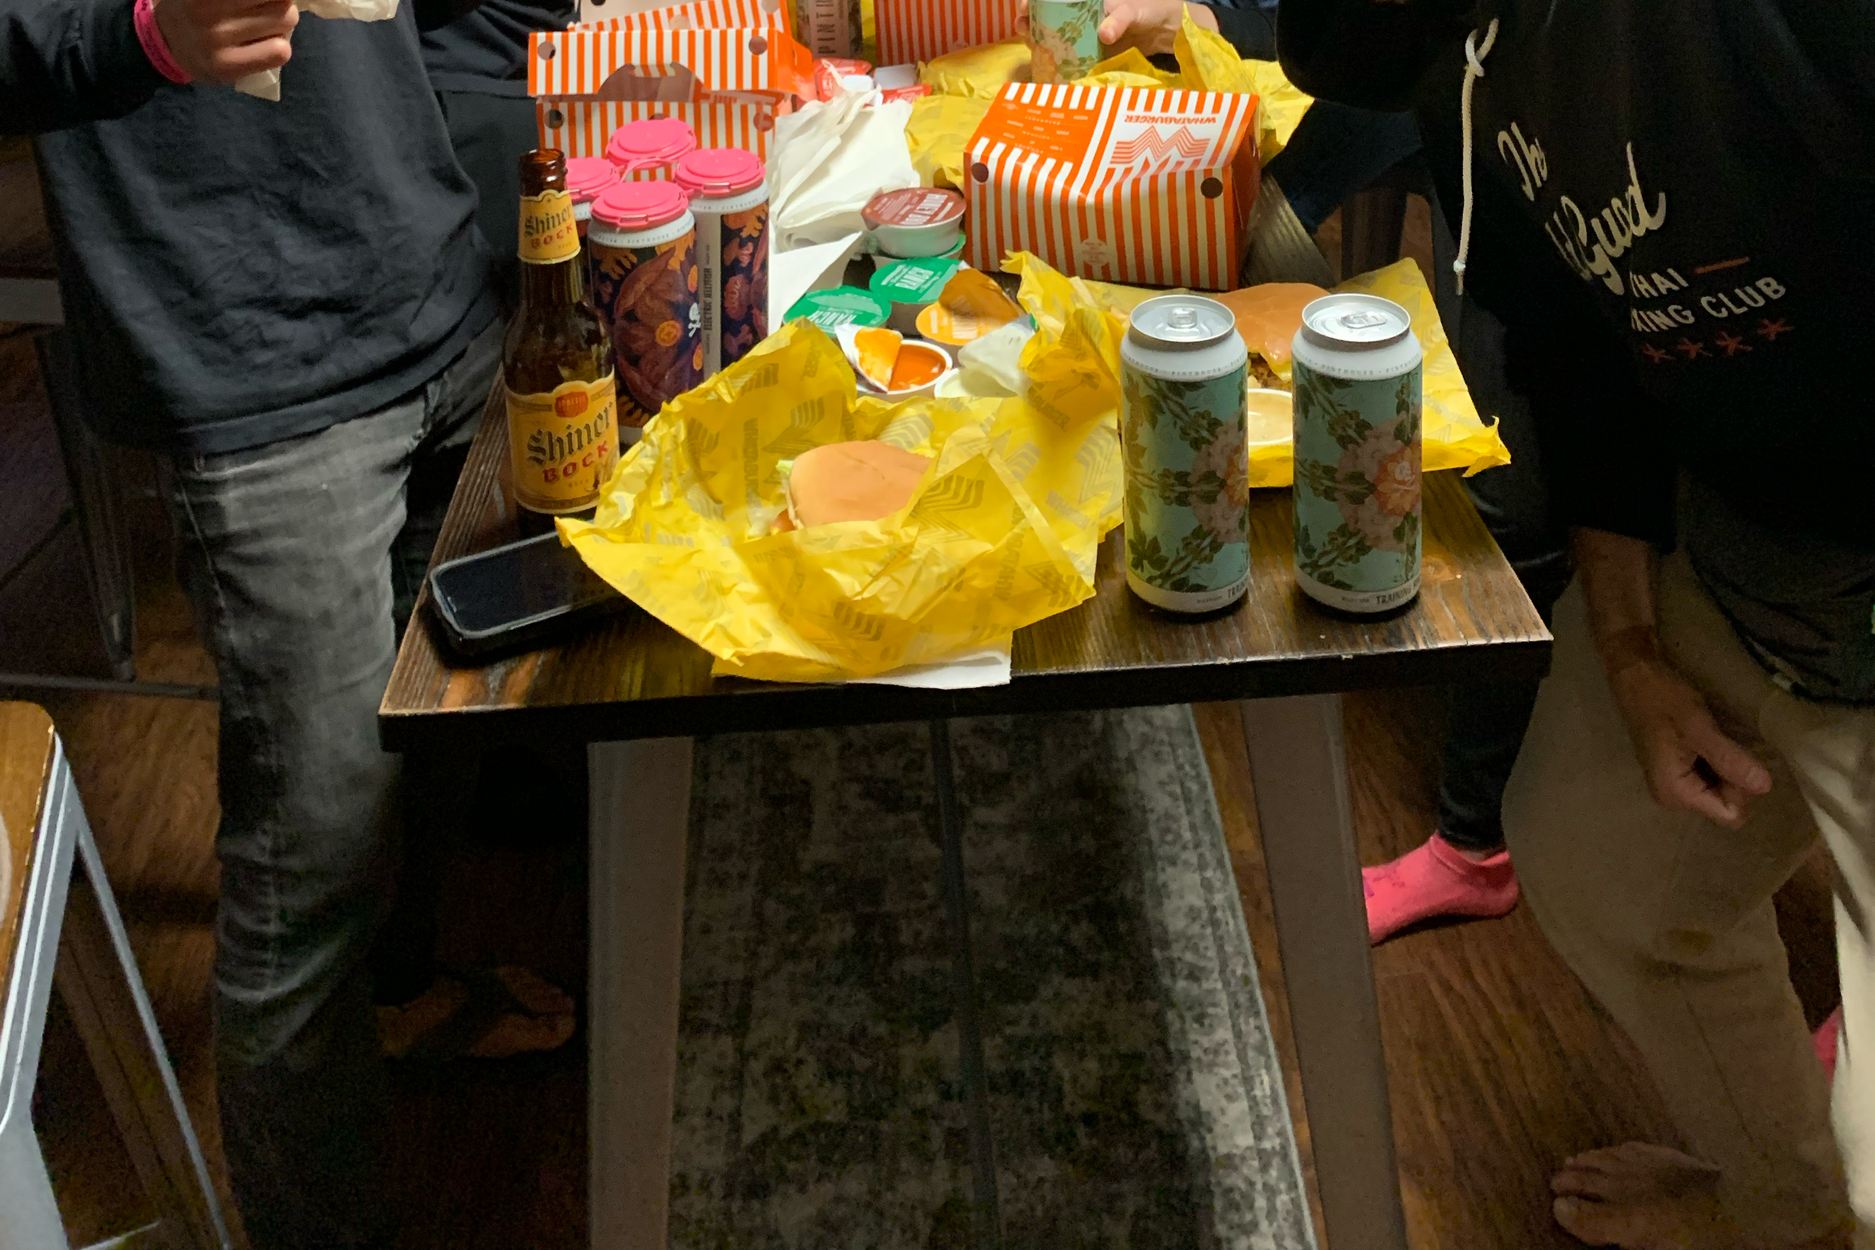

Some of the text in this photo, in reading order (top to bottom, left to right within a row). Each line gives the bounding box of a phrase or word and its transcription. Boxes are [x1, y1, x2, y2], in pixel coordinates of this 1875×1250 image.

[1124, 113, 1217, 125] WHATABURGER
[524, 203, 571, 237] Shiner
[531, 223, 573, 249] BOCK
[1700, 276, 1787, 318] CLUB
[527, 401, 613, 466] Shiner
[543, 440, 608, 484] BOCK
